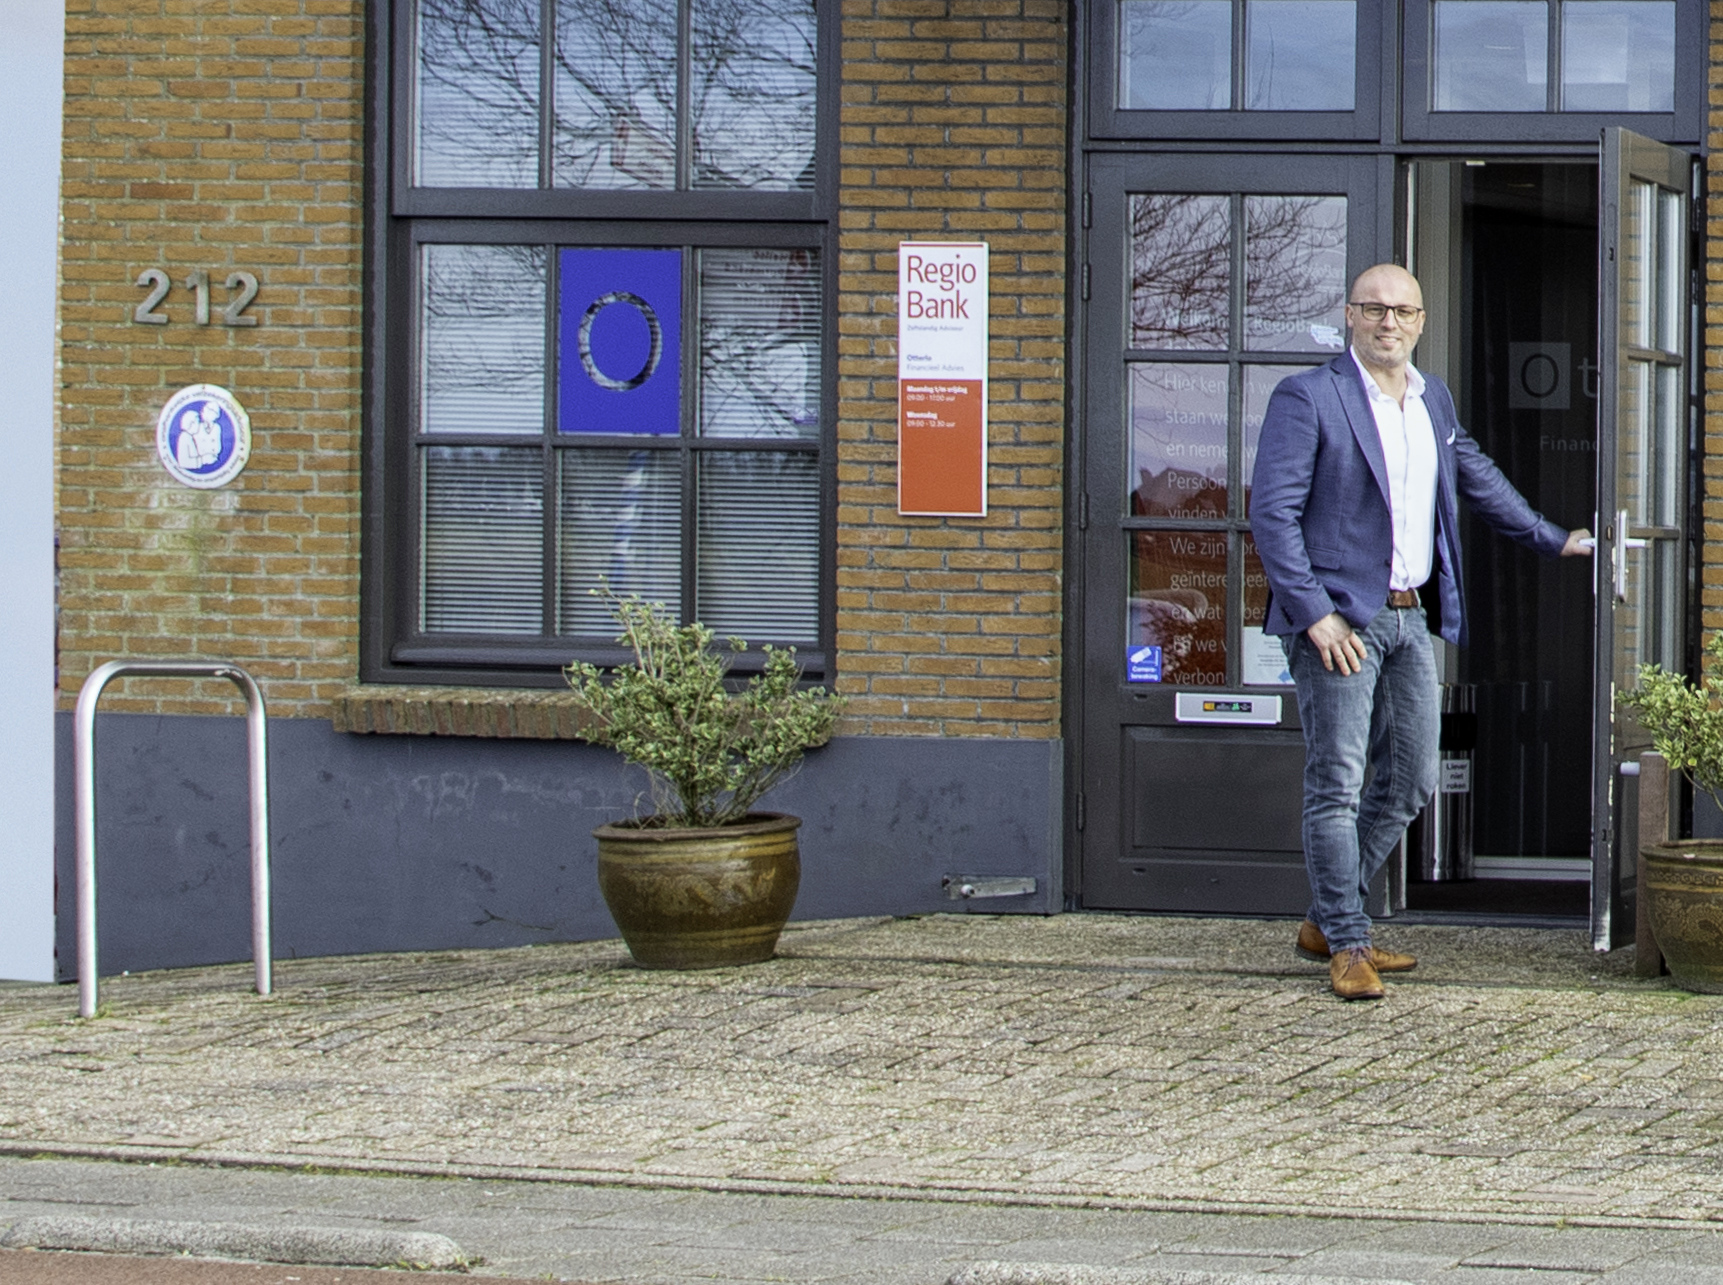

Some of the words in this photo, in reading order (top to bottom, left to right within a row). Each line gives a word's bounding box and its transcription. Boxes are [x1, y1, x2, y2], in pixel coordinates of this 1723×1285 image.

[906, 254, 977, 292] Regio
[134, 268, 259, 326] 212
[906, 289, 970, 319] Bank
[1165, 410, 1206, 425] staan
[1166, 442, 1185, 457] en
[1169, 536, 1196, 555] We
[1200, 537, 1226, 559] zijn
[1195, 639, 1217, 653] we
